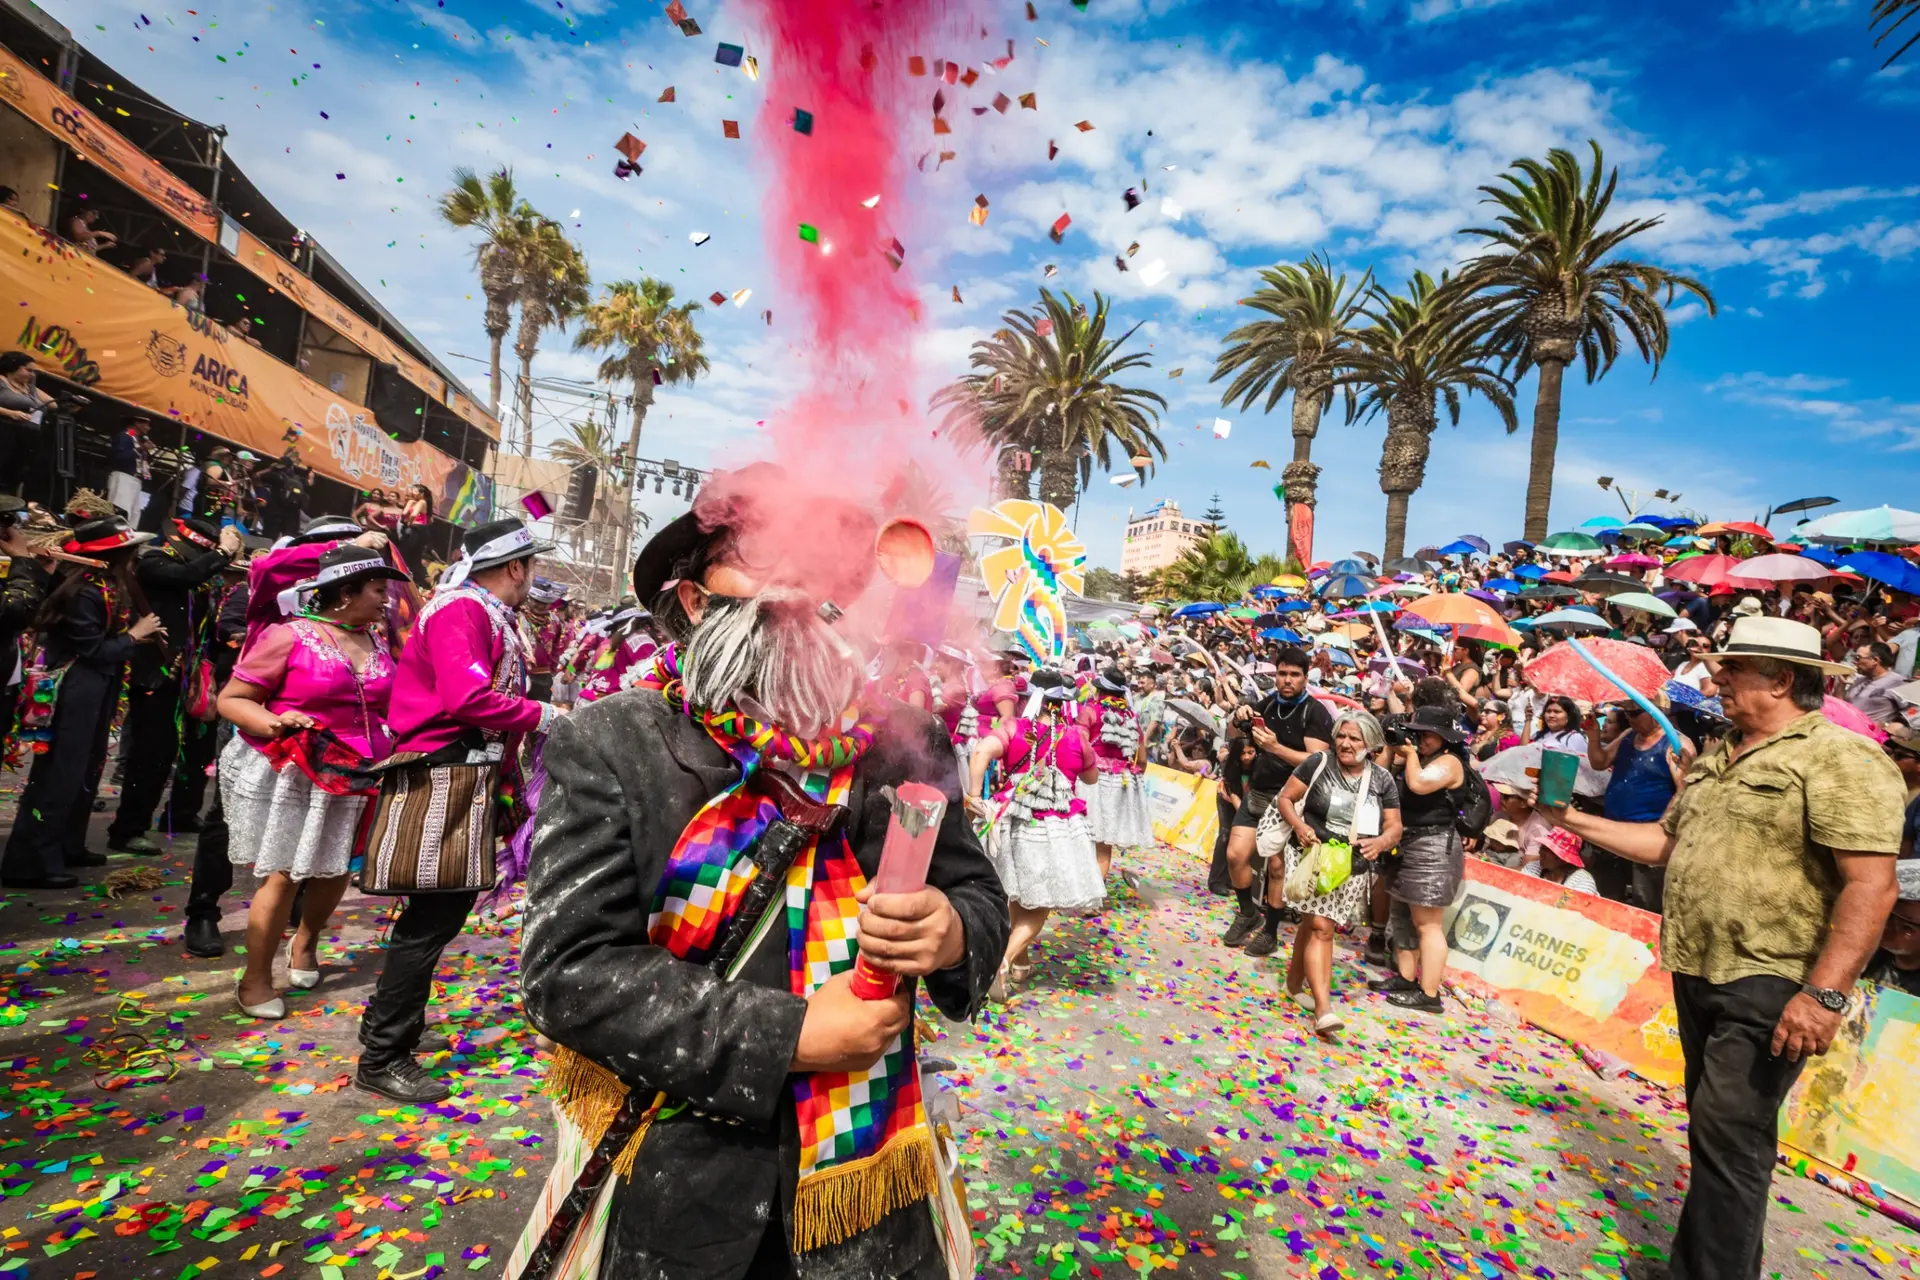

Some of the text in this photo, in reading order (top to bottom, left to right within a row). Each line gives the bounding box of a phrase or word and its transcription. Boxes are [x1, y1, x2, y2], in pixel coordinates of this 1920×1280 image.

[192, 353, 249, 399] ARICA
[1499, 942, 1581, 982] ARAUCO
[1510, 924, 1588, 962] CARNES
